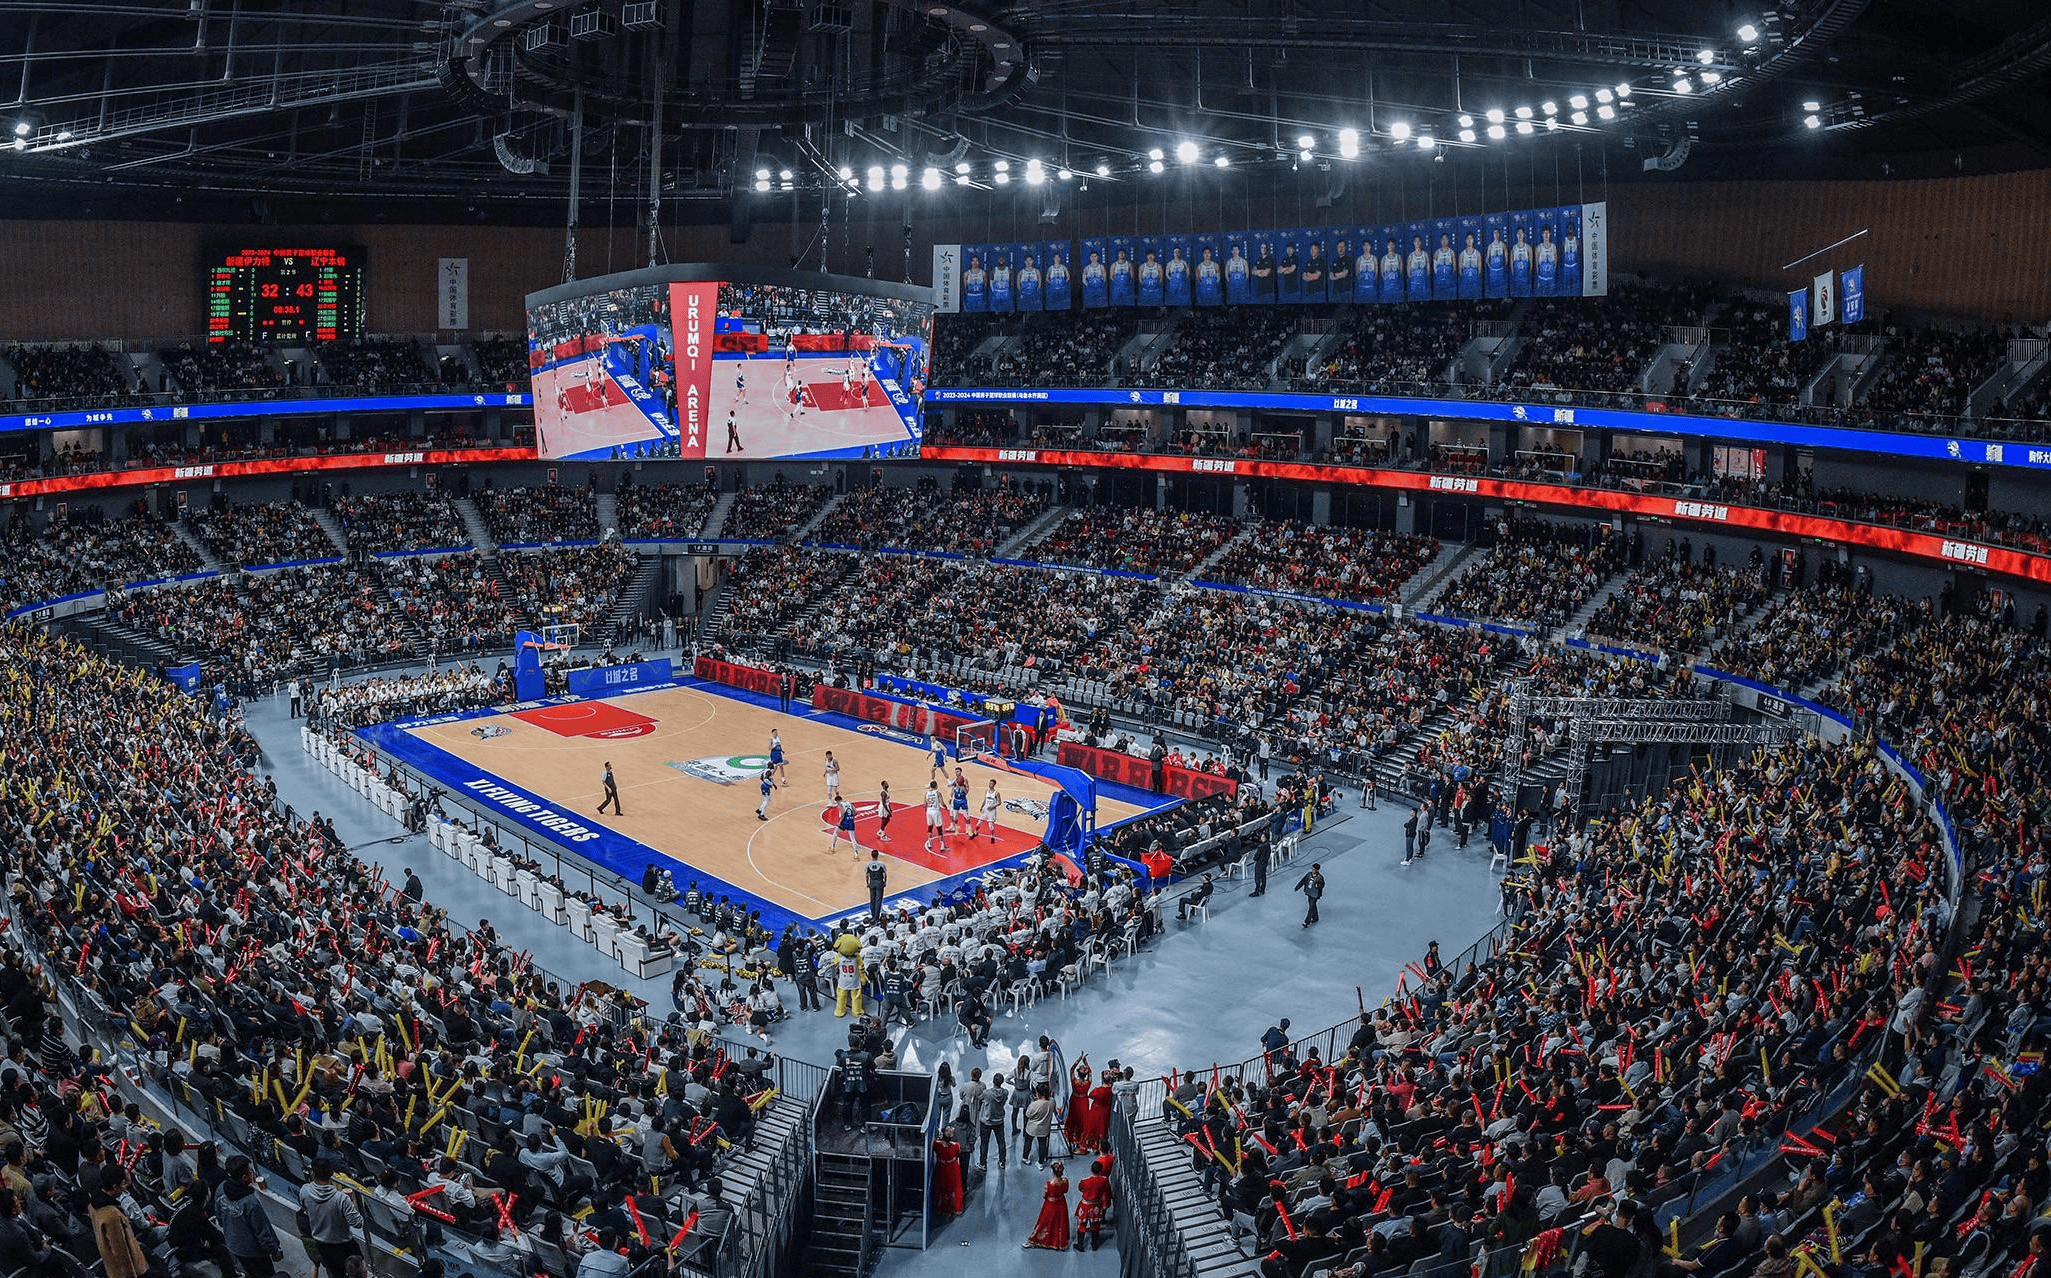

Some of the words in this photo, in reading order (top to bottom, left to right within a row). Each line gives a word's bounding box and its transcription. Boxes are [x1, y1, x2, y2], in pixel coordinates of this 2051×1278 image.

[284, 257, 293, 266] VS
[261, 284, 279, 297] 32
[296, 284, 314, 297] 43
[688, 294, 699, 371] URUMQI
[1333, 398, 1358, 409] 以城之名
[687, 384, 699, 448] ARENA
[2029, 450, 2051, 464] 胸怀大
[605, 667, 638, 684] 以城之名
[485, 786, 542, 813] FLYING
[526, 809, 600, 842] TIGERS
